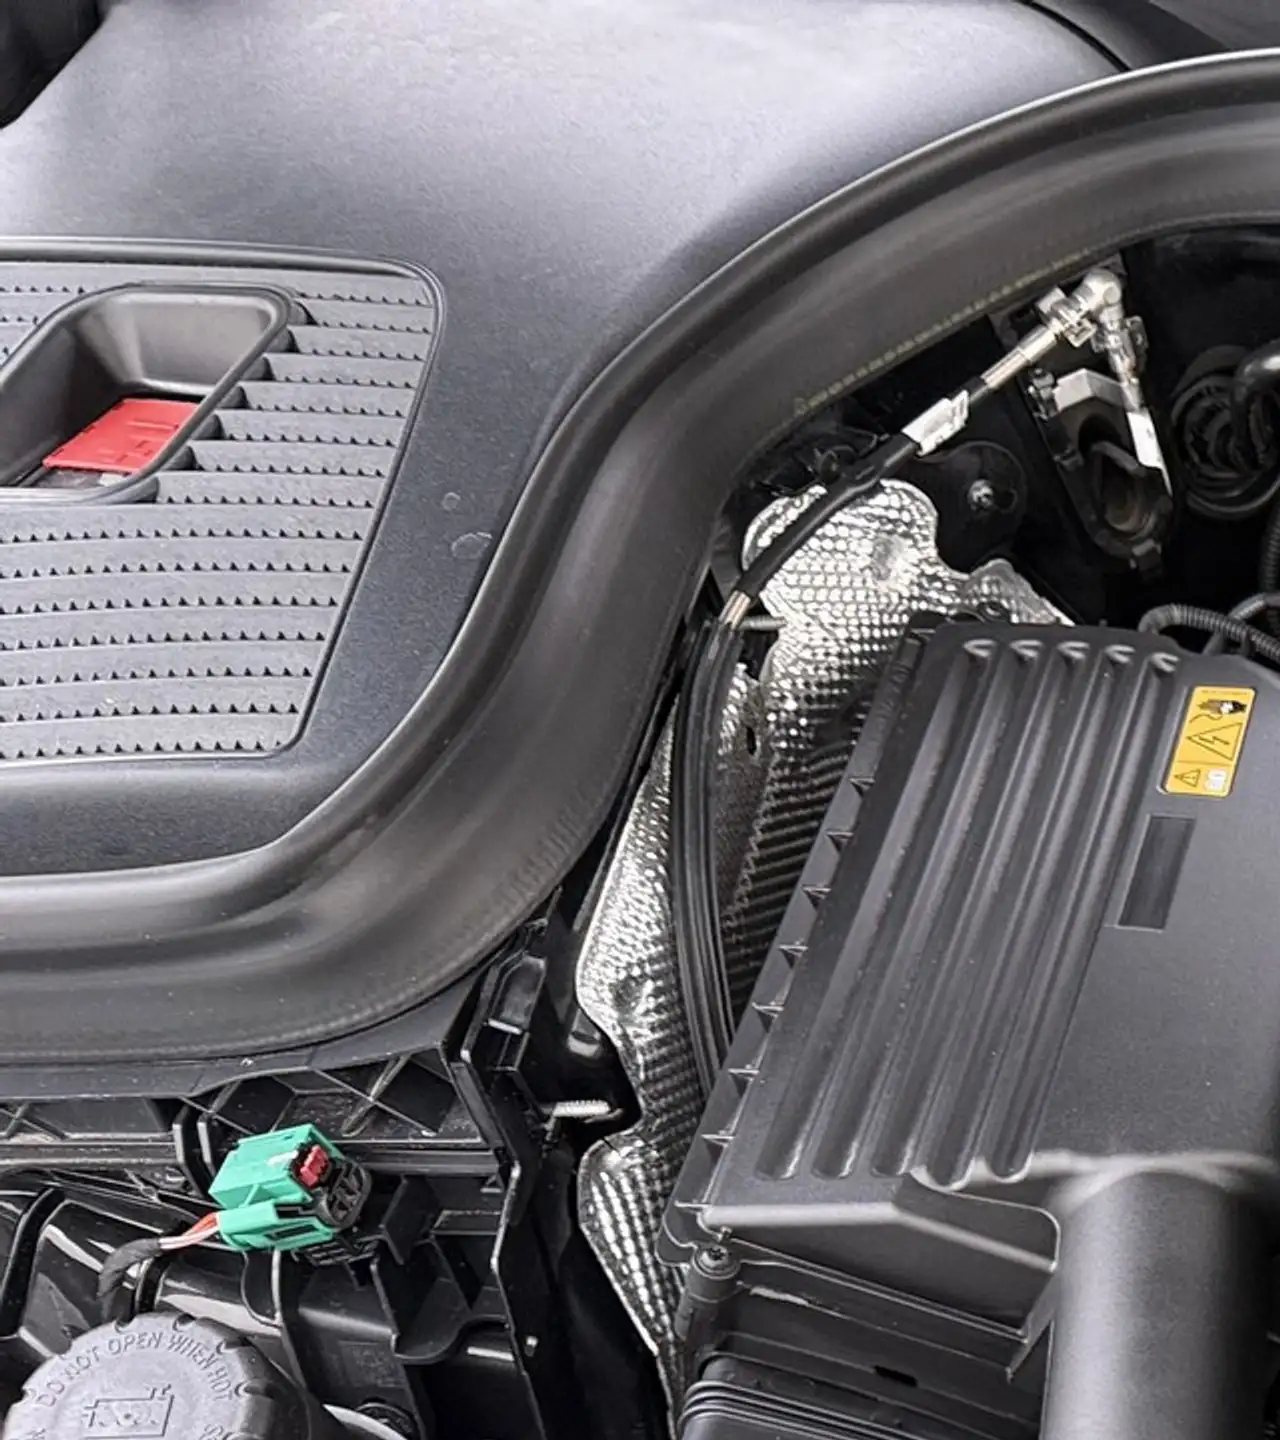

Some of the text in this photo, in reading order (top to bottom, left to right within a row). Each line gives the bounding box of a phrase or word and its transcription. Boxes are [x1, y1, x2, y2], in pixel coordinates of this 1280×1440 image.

[36, 1330, 234, 1407] DO NOT OPEN WHEN HOT
